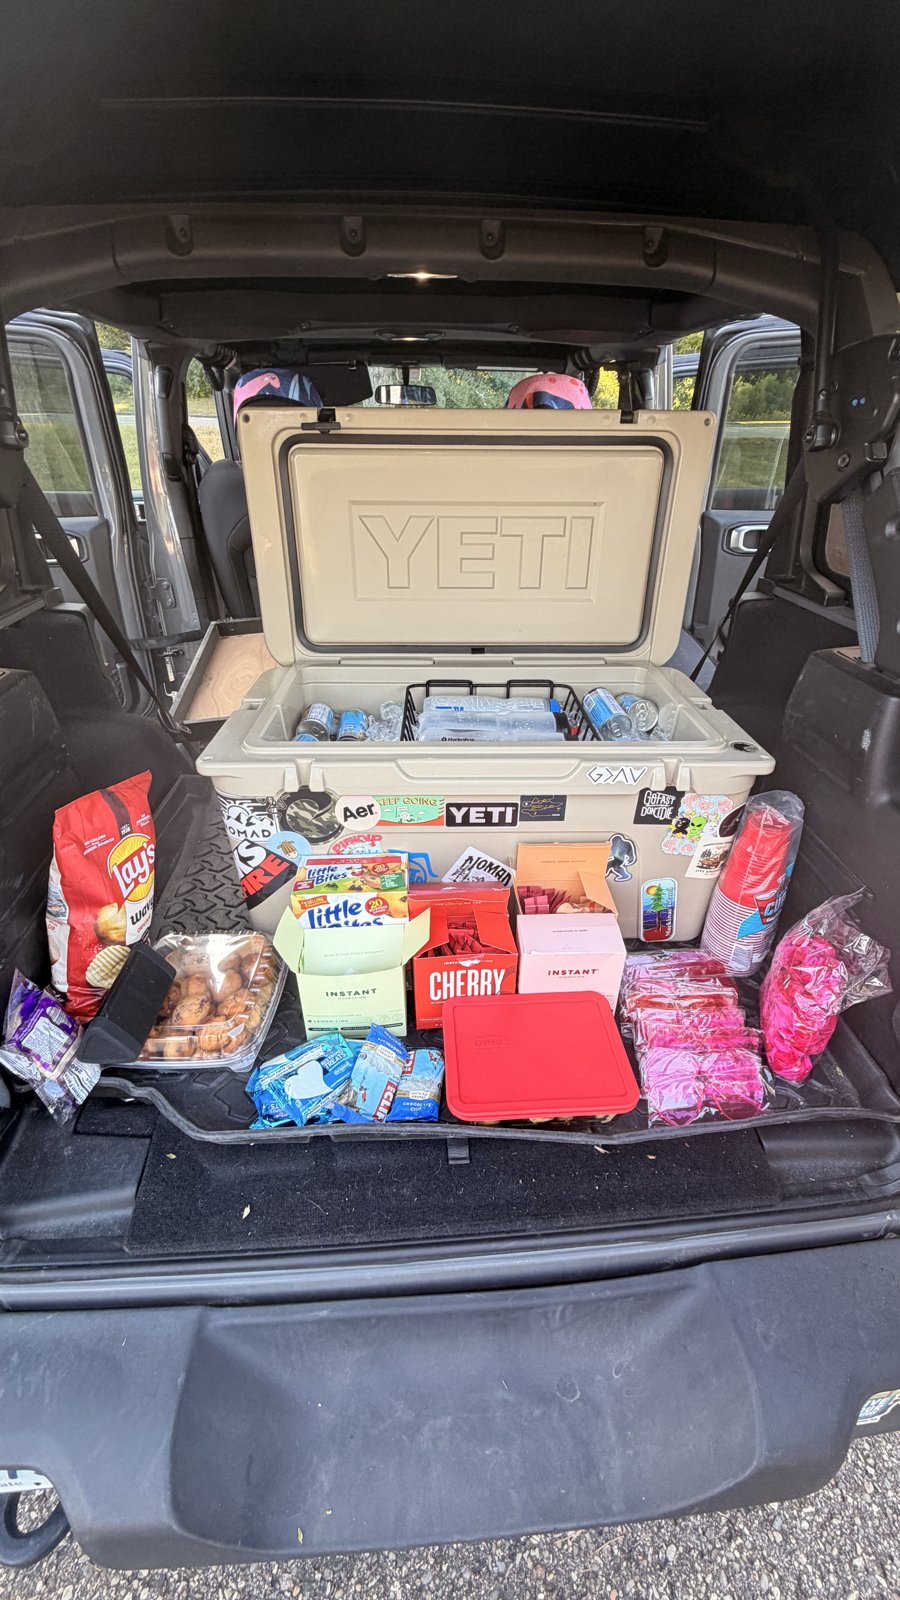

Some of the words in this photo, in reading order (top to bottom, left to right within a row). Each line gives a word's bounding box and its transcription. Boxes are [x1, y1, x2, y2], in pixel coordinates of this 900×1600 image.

[358, 515, 594, 590] YETI
[402, 796, 439, 807] GOING
[448, 806, 513, 825] YETI
[112, 842, 155, 898] Lay's
[307, 865, 338, 880] Little
[315, 871, 347, 885] Bites
[369, 899, 384, 908] 20
[307, 899, 363, 929] Little
[547, 968, 597, 976] INSTANT
[429, 968, 506, 1001] CHERRY
[325, 987, 377, 998] INSTANT
